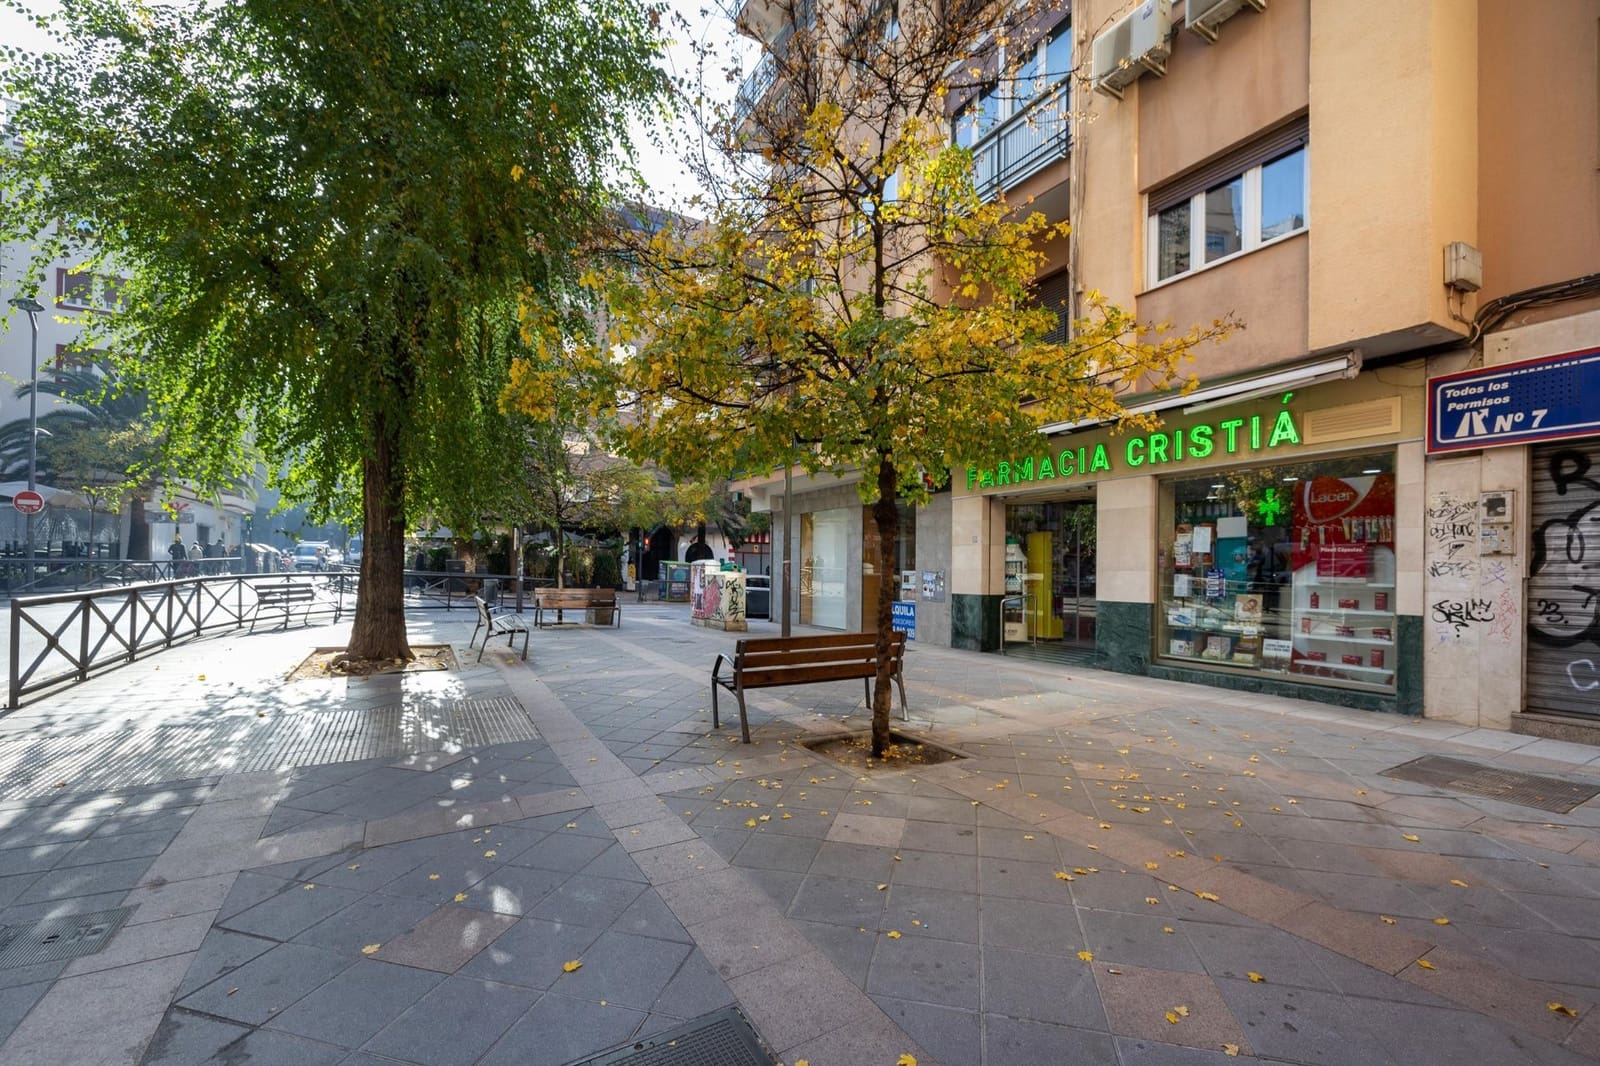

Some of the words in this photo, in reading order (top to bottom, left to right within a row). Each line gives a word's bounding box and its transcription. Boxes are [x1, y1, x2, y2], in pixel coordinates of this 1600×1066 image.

[1445, 386, 1484, 398] Todos
[1488, 381, 1509, 392] los
[1447, 395, 1511, 412] Permisos
[1493, 412, 1525, 433] Nº
[1531, 408, 1549, 429] 7
[967, 443, 1110, 490] FARMACIA
[1126, 392, 1300, 467] CRISTIÁ
[1311, 491, 1354, 503] Lacer
[892, 605, 915, 616] LQUILA
